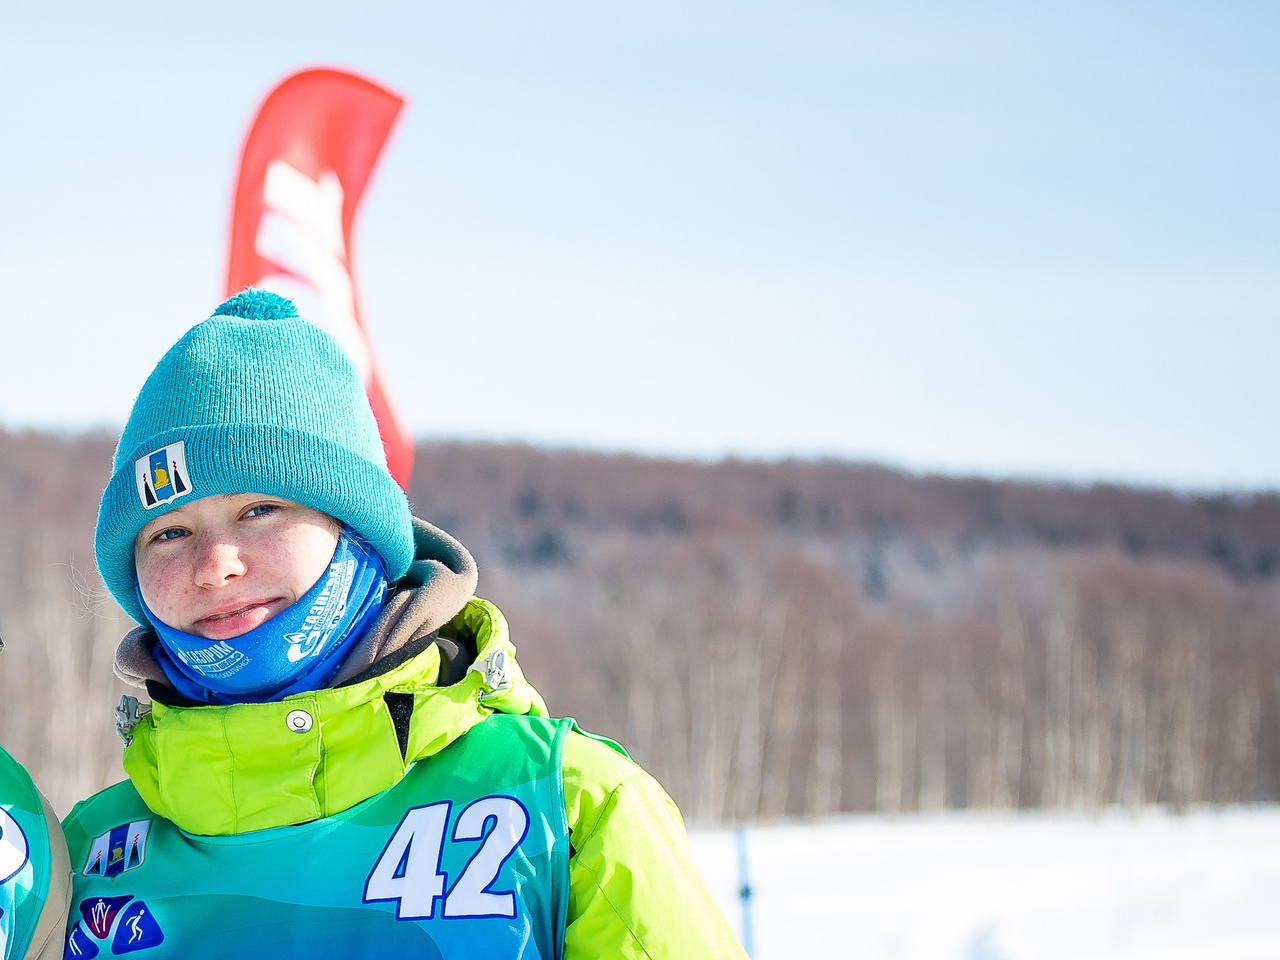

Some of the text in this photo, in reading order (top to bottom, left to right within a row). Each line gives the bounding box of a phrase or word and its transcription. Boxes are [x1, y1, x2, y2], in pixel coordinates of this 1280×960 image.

[301, 562, 343, 630] ГАЗПРОМ
[186, 640, 235, 665] ГАЗПРОМ
[362, 794, 531, 921] 42
